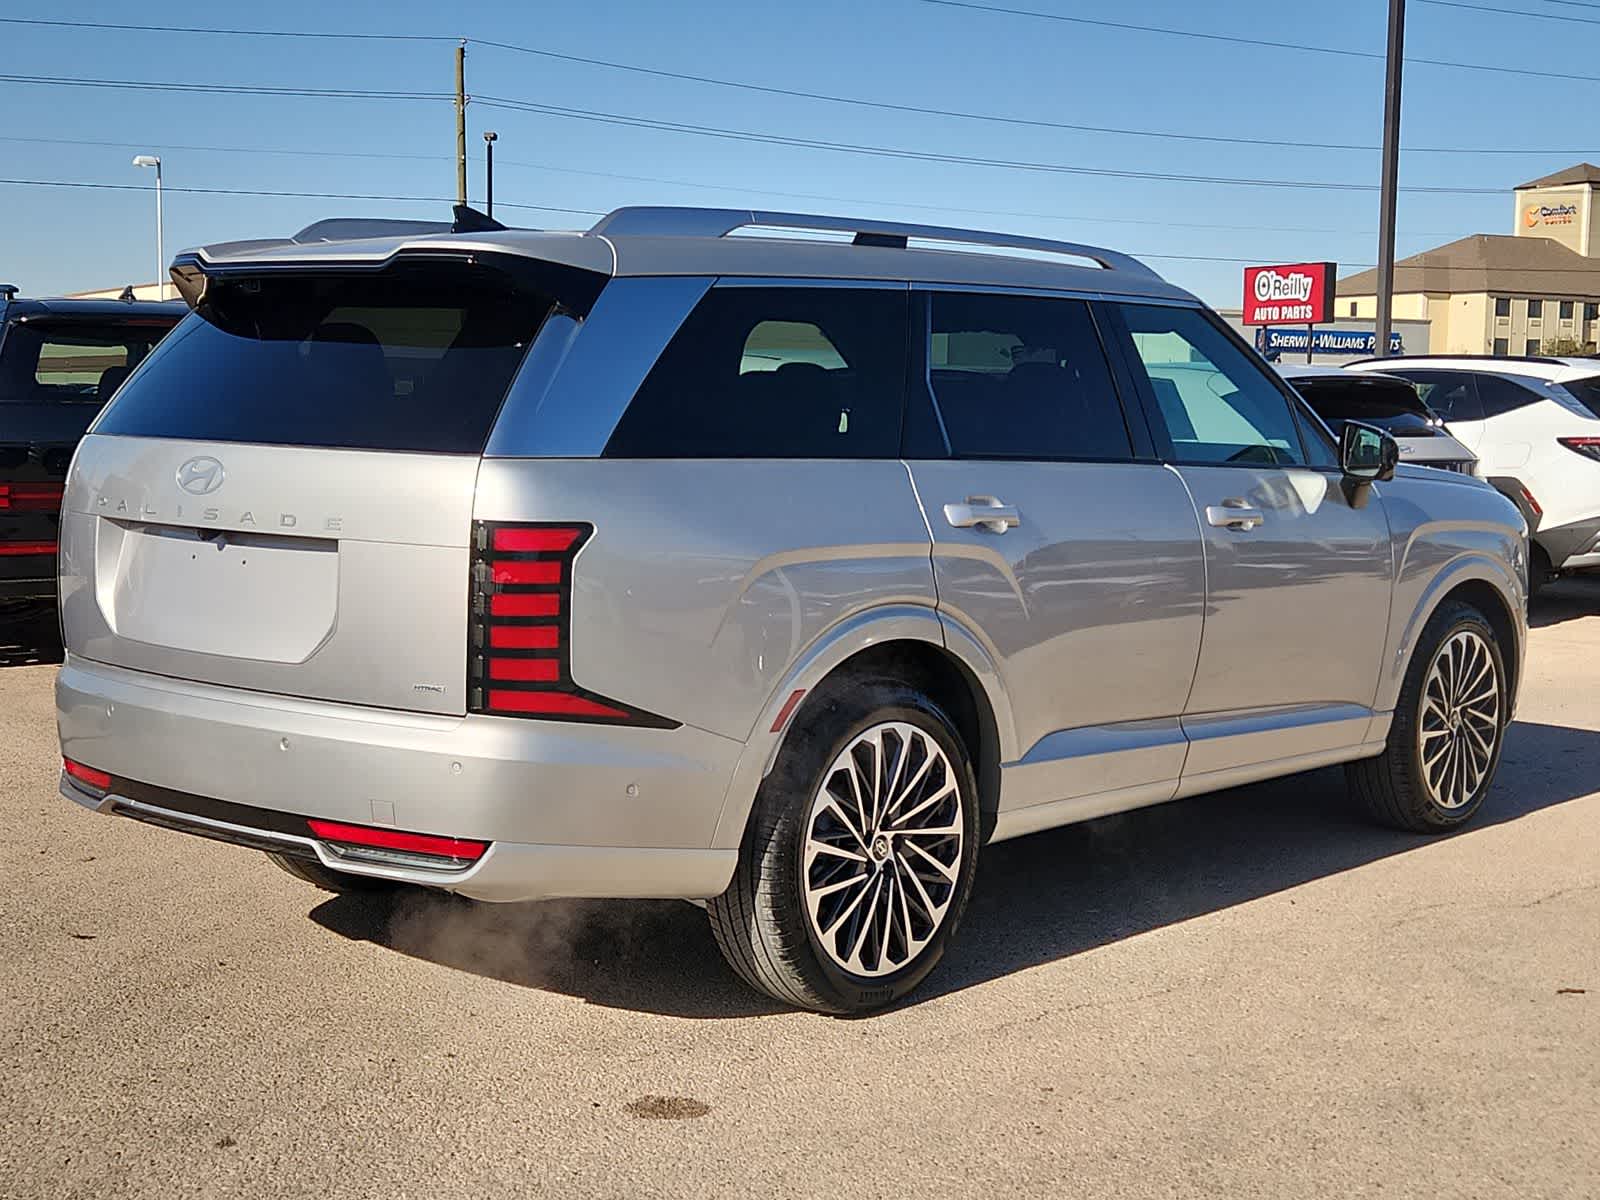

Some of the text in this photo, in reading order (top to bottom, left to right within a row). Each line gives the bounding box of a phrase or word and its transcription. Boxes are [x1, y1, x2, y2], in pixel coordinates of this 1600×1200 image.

[1256, 272, 1312, 300] O'Reilly
[1254, 304, 1313, 320] AUTO PARTS
[97, 496, 343, 532] PALISADE
